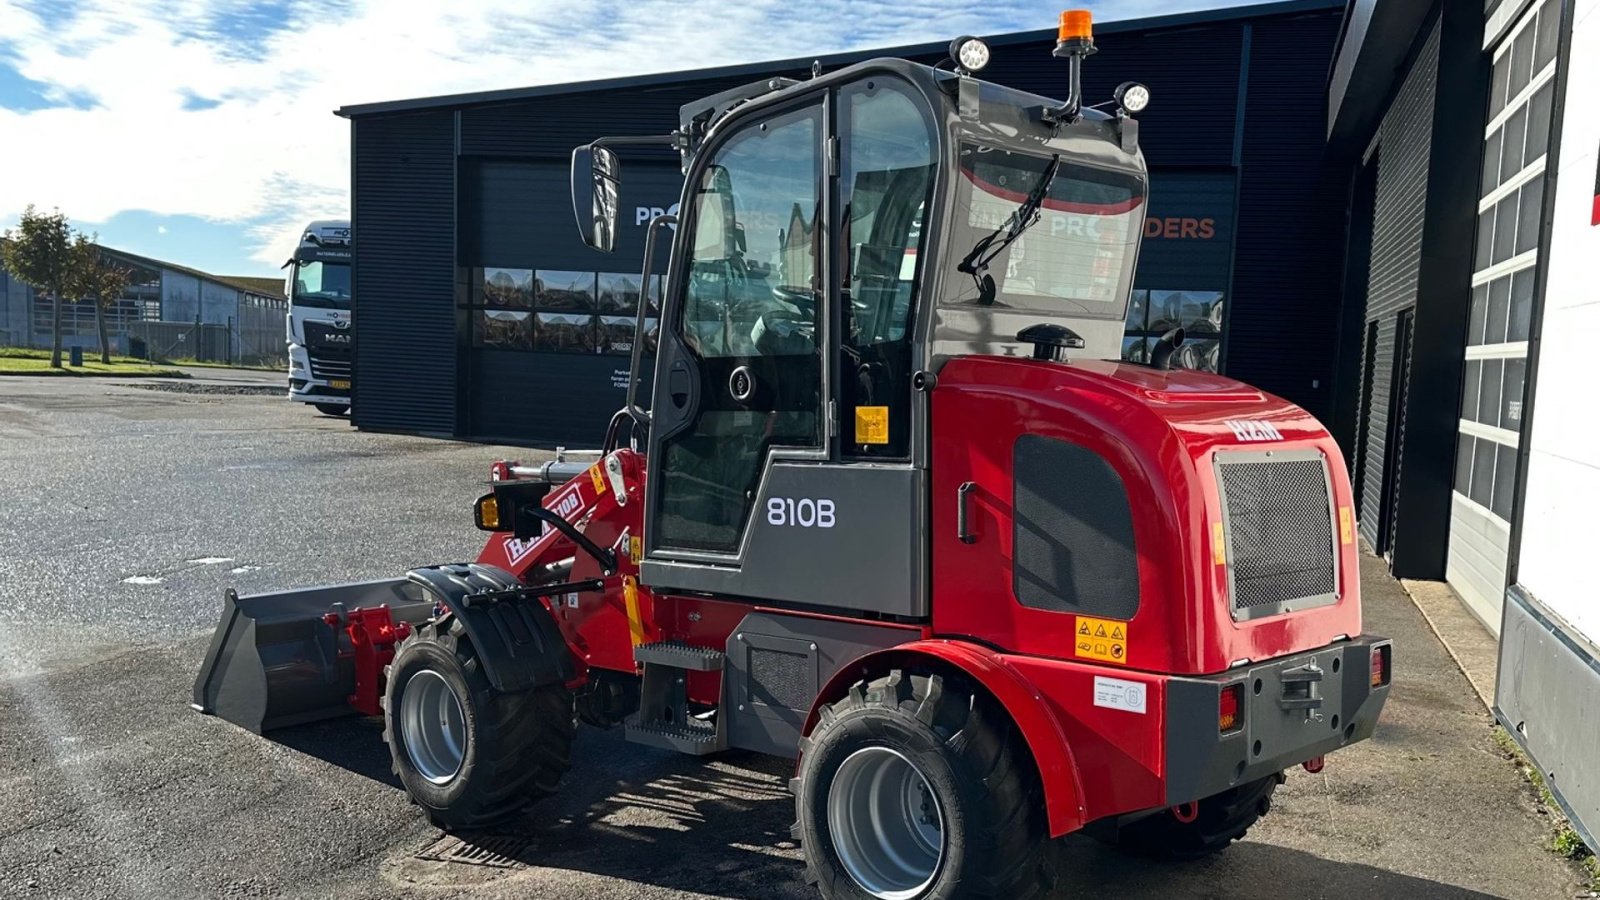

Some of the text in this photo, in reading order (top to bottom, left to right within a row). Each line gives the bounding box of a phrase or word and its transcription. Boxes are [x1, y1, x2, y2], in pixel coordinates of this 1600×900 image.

[1143, 217, 1215, 239] DERS
[1223, 419, 1284, 442] HZM
[766, 497, 836, 528] 810B
